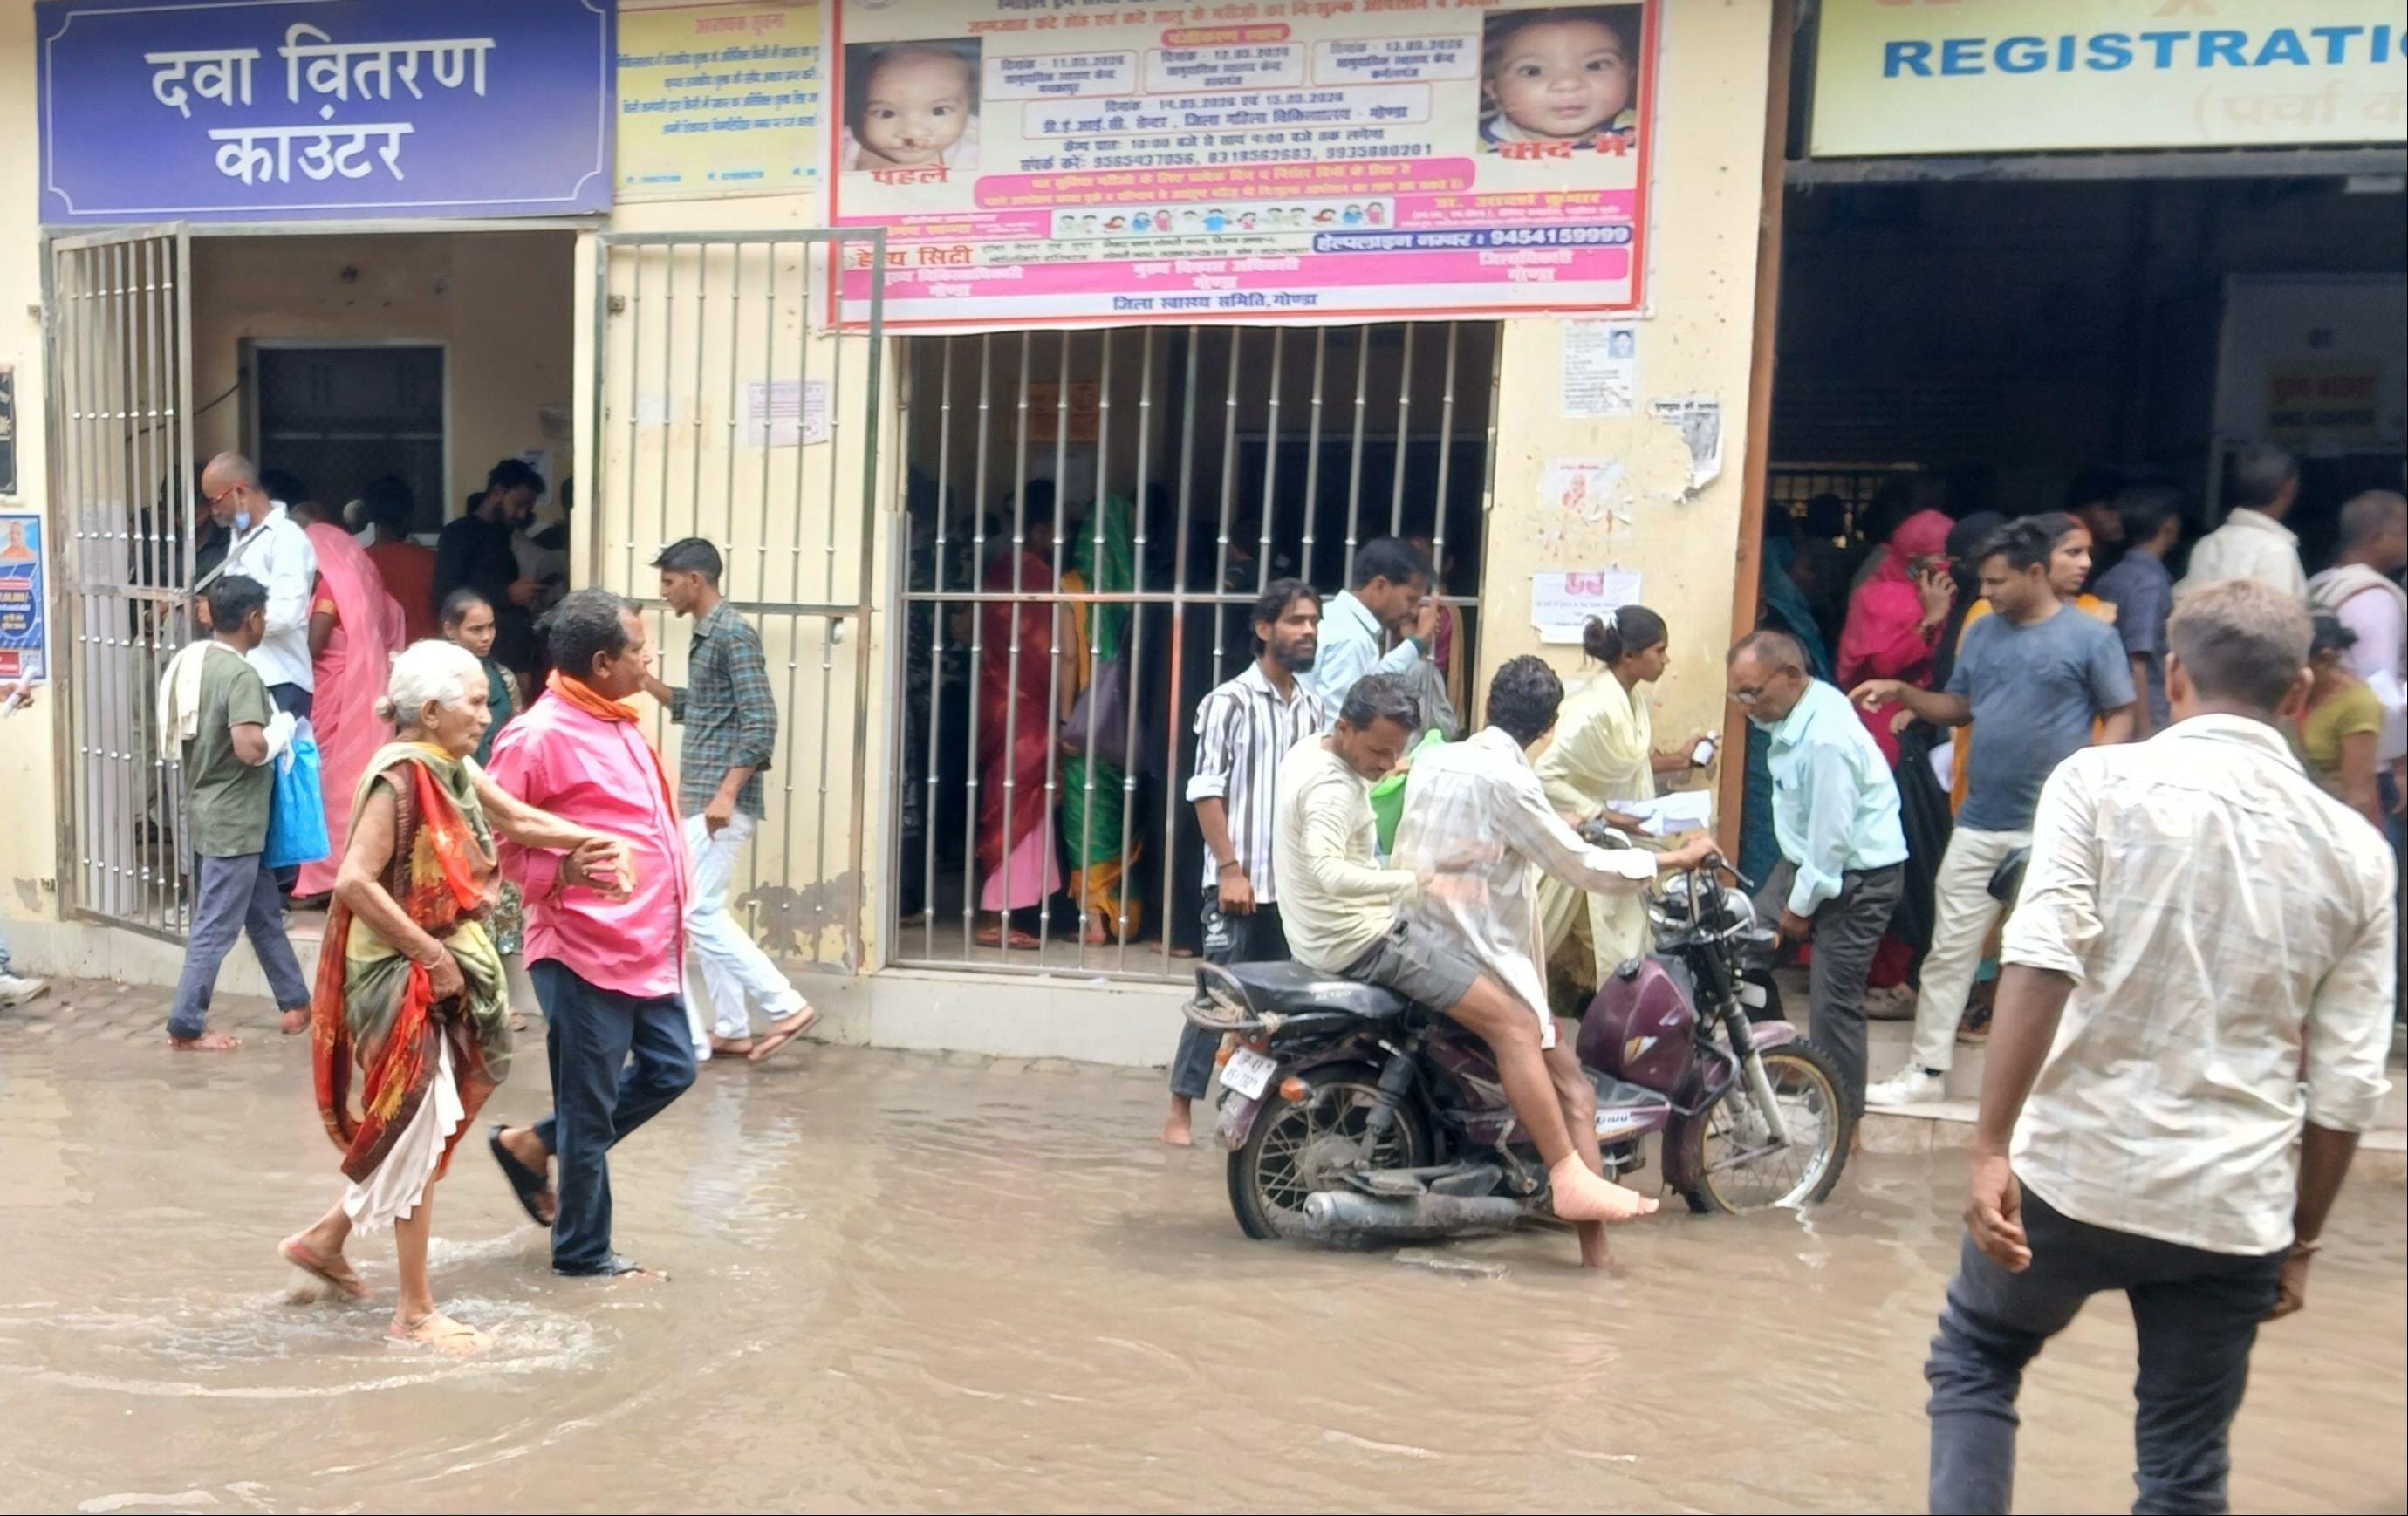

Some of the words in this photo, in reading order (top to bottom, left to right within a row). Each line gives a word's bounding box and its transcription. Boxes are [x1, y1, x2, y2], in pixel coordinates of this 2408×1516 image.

[1882, 25, 2406, 78] REGISTRATI
[144, 47, 261, 119] दवा
[277, 23, 496, 103] वितरण
[1184, 113, 1221, 127] जिला
[207, 104, 415, 186] काउंटर
[871, 163, 951, 186] पहले
[1316, 232, 1414, 251] हेल्पलाइन
[1417, 232, 1473, 248] नम्बर
[1489, 227, 1630, 246] 9454159999
[856, 248, 908, 268] हेथ
[918, 244, 975, 265] सिटी
[1112, 297, 1153, 311] जिला
